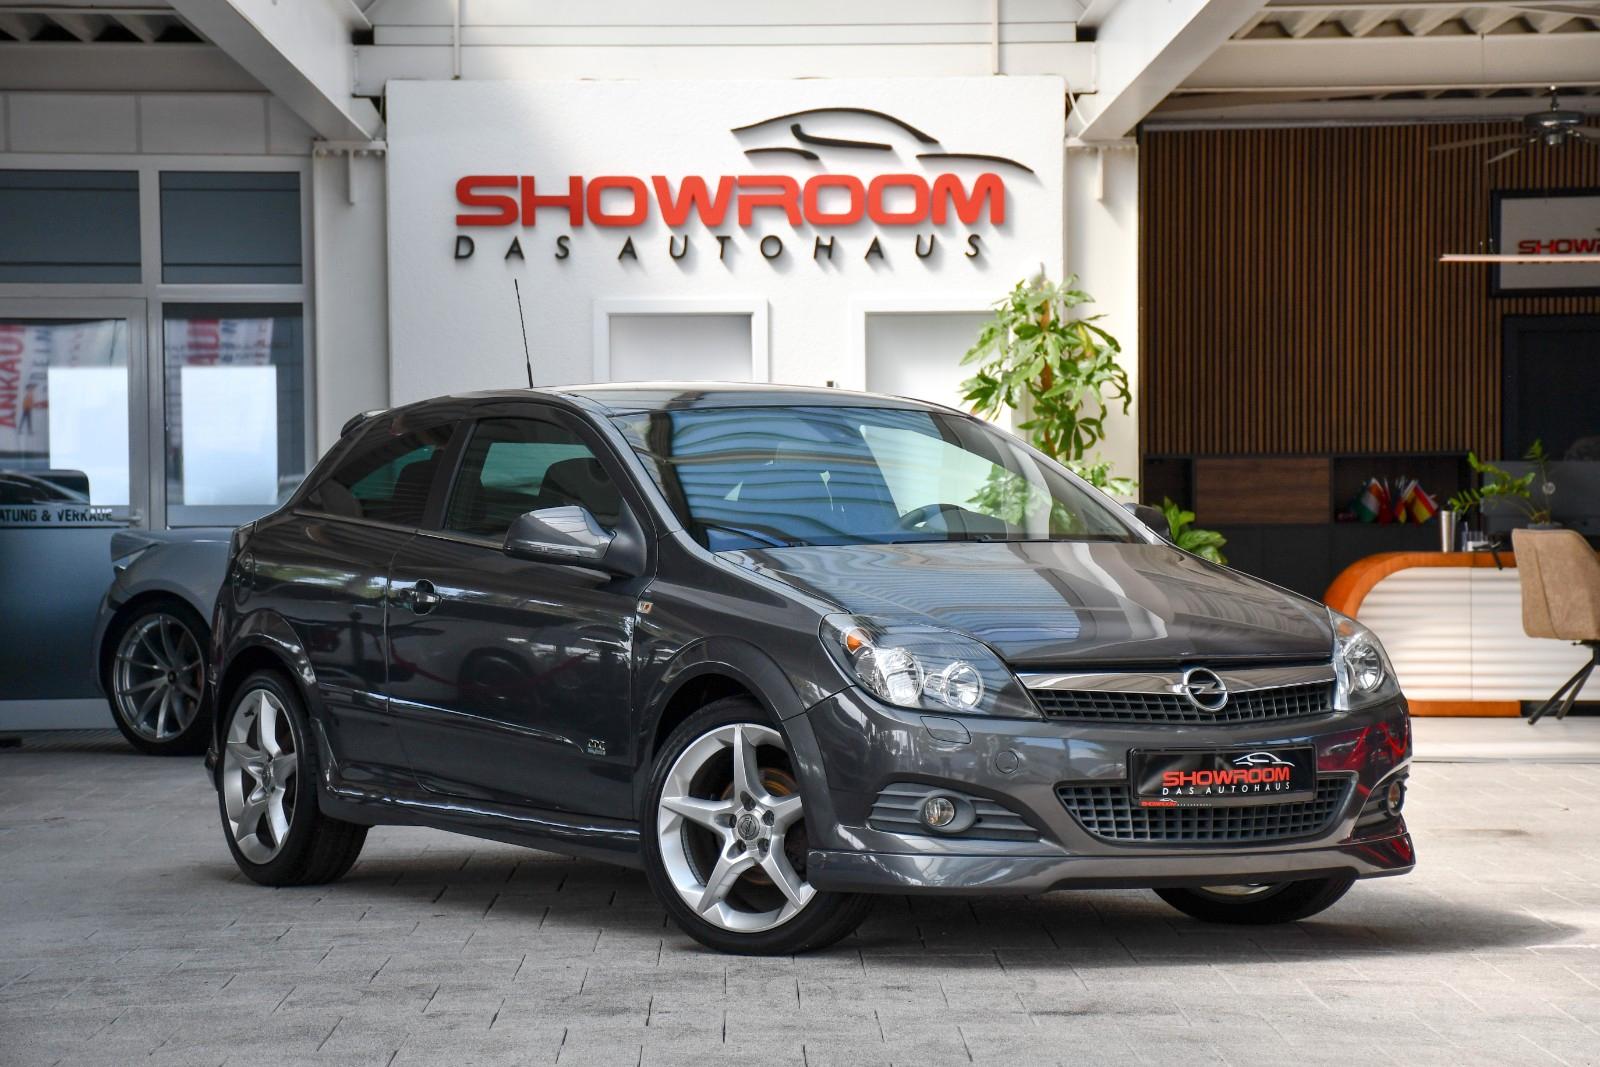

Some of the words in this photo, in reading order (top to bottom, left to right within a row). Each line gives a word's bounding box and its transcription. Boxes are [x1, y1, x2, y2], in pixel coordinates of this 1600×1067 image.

[455, 173, 1005, 227] SHOWROOM
[454, 235, 571, 260] DAS
[618, 233, 982, 260] AUTOHAUS
[1517, 238, 1600, 255] SHOW
[41, 509, 51, 522] &
[1162, 767, 1290, 787] SHOWROOM
[1162, 786, 1194, 796] DAS
[1205, 781, 1290, 795] AUTOHAUS
